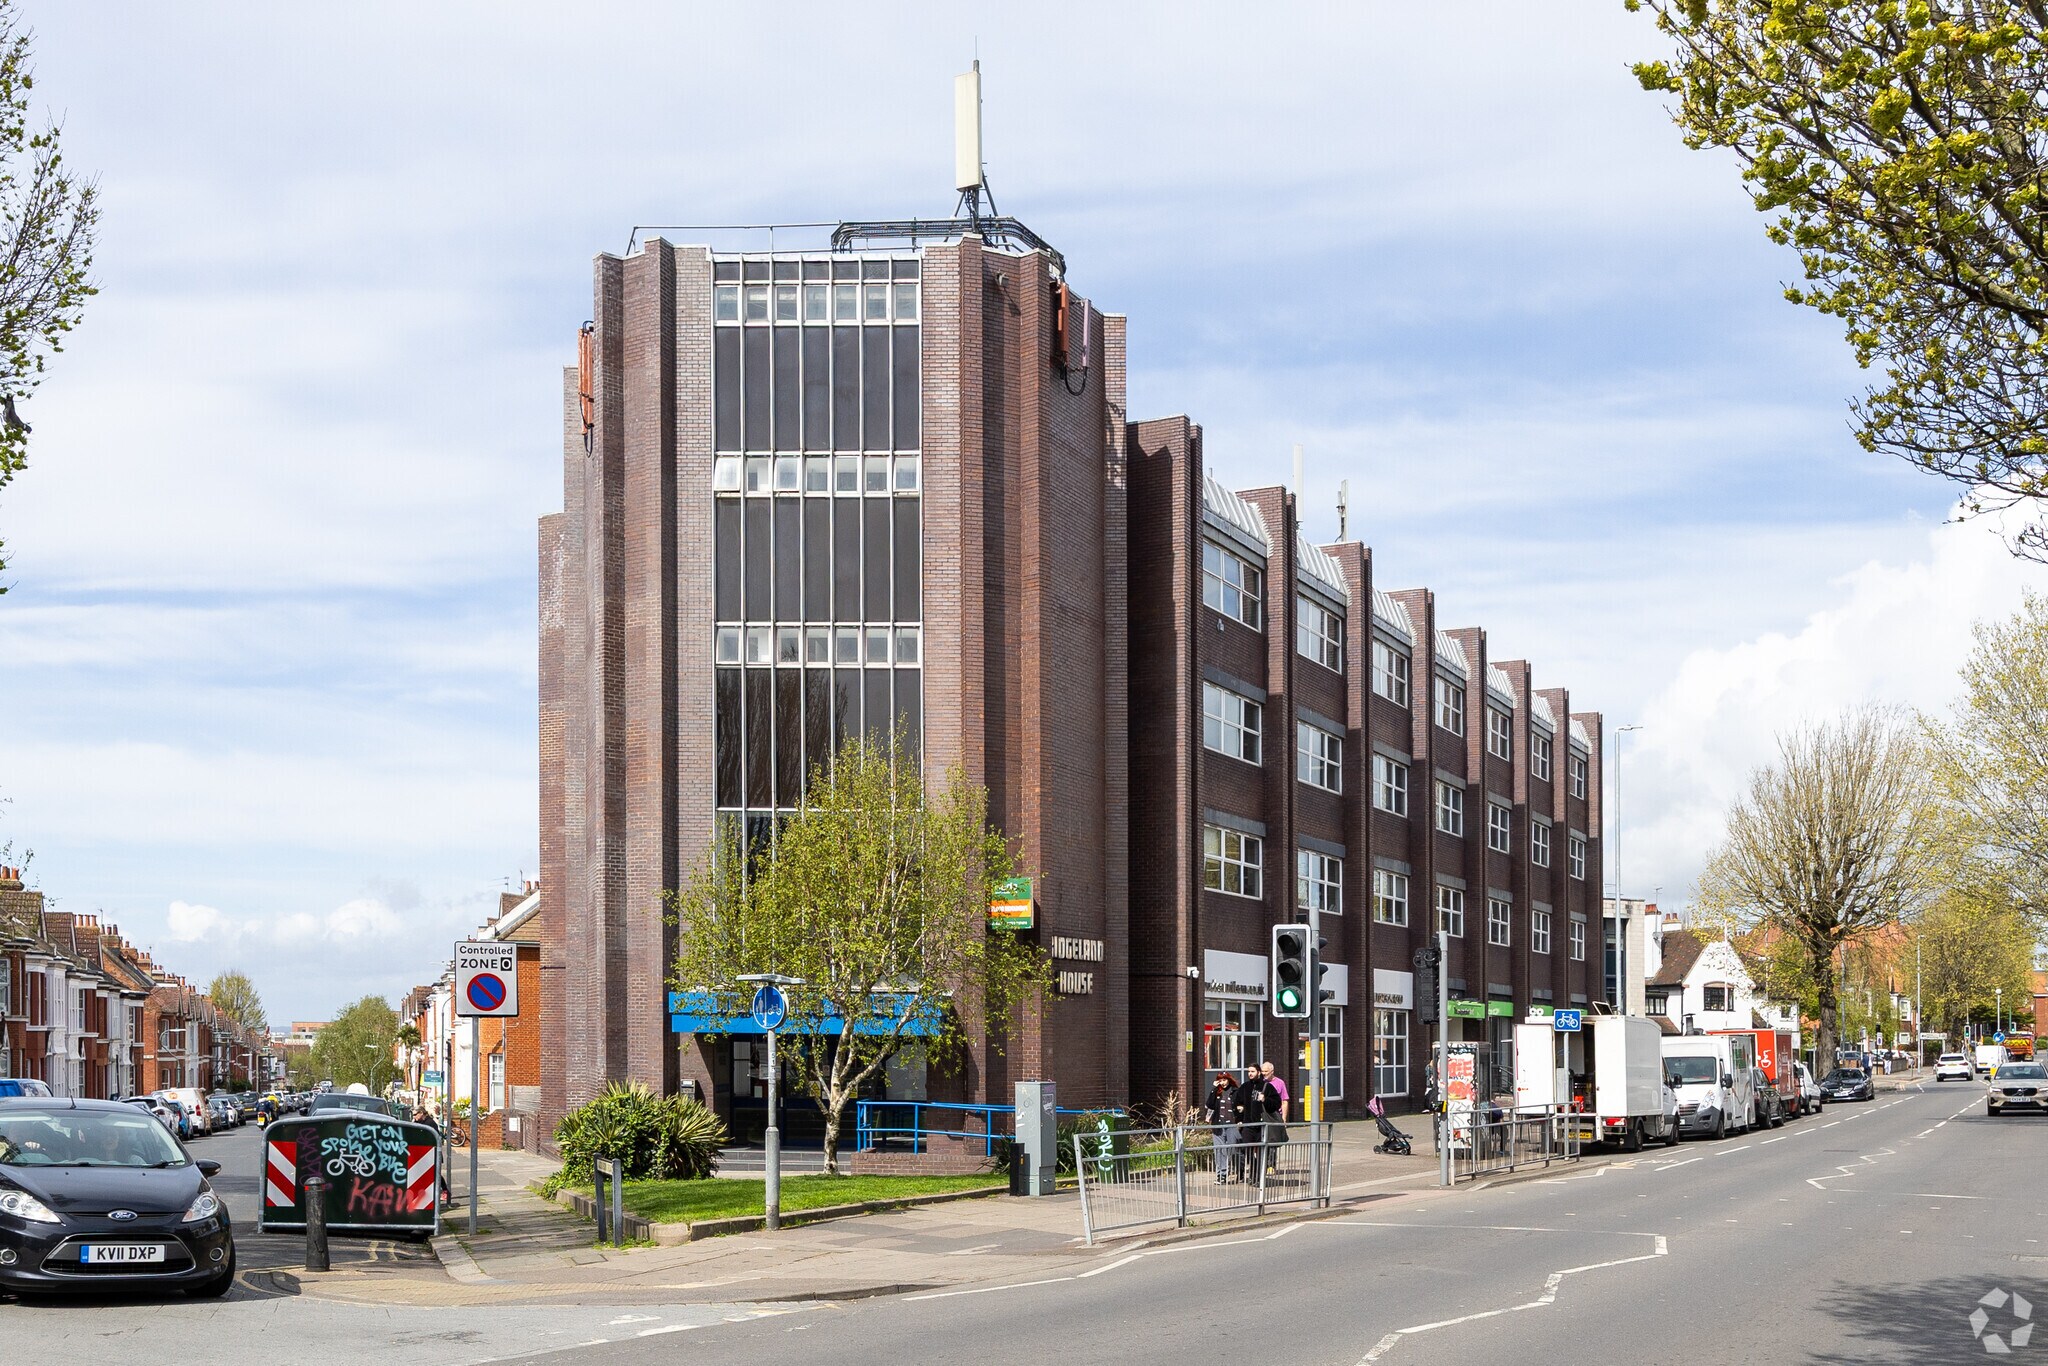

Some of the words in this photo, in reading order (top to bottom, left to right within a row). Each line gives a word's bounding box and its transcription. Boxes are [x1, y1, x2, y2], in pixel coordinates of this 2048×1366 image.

[459, 945, 513, 955] Controlled
[460, 958, 498, 969] ZONE
[1059, 970, 1093, 995] HOUSE
[345, 1123, 381, 1140] GET
[372, 1138, 411, 1156] YOUR
[128, 1247, 157, 1260] DXP
